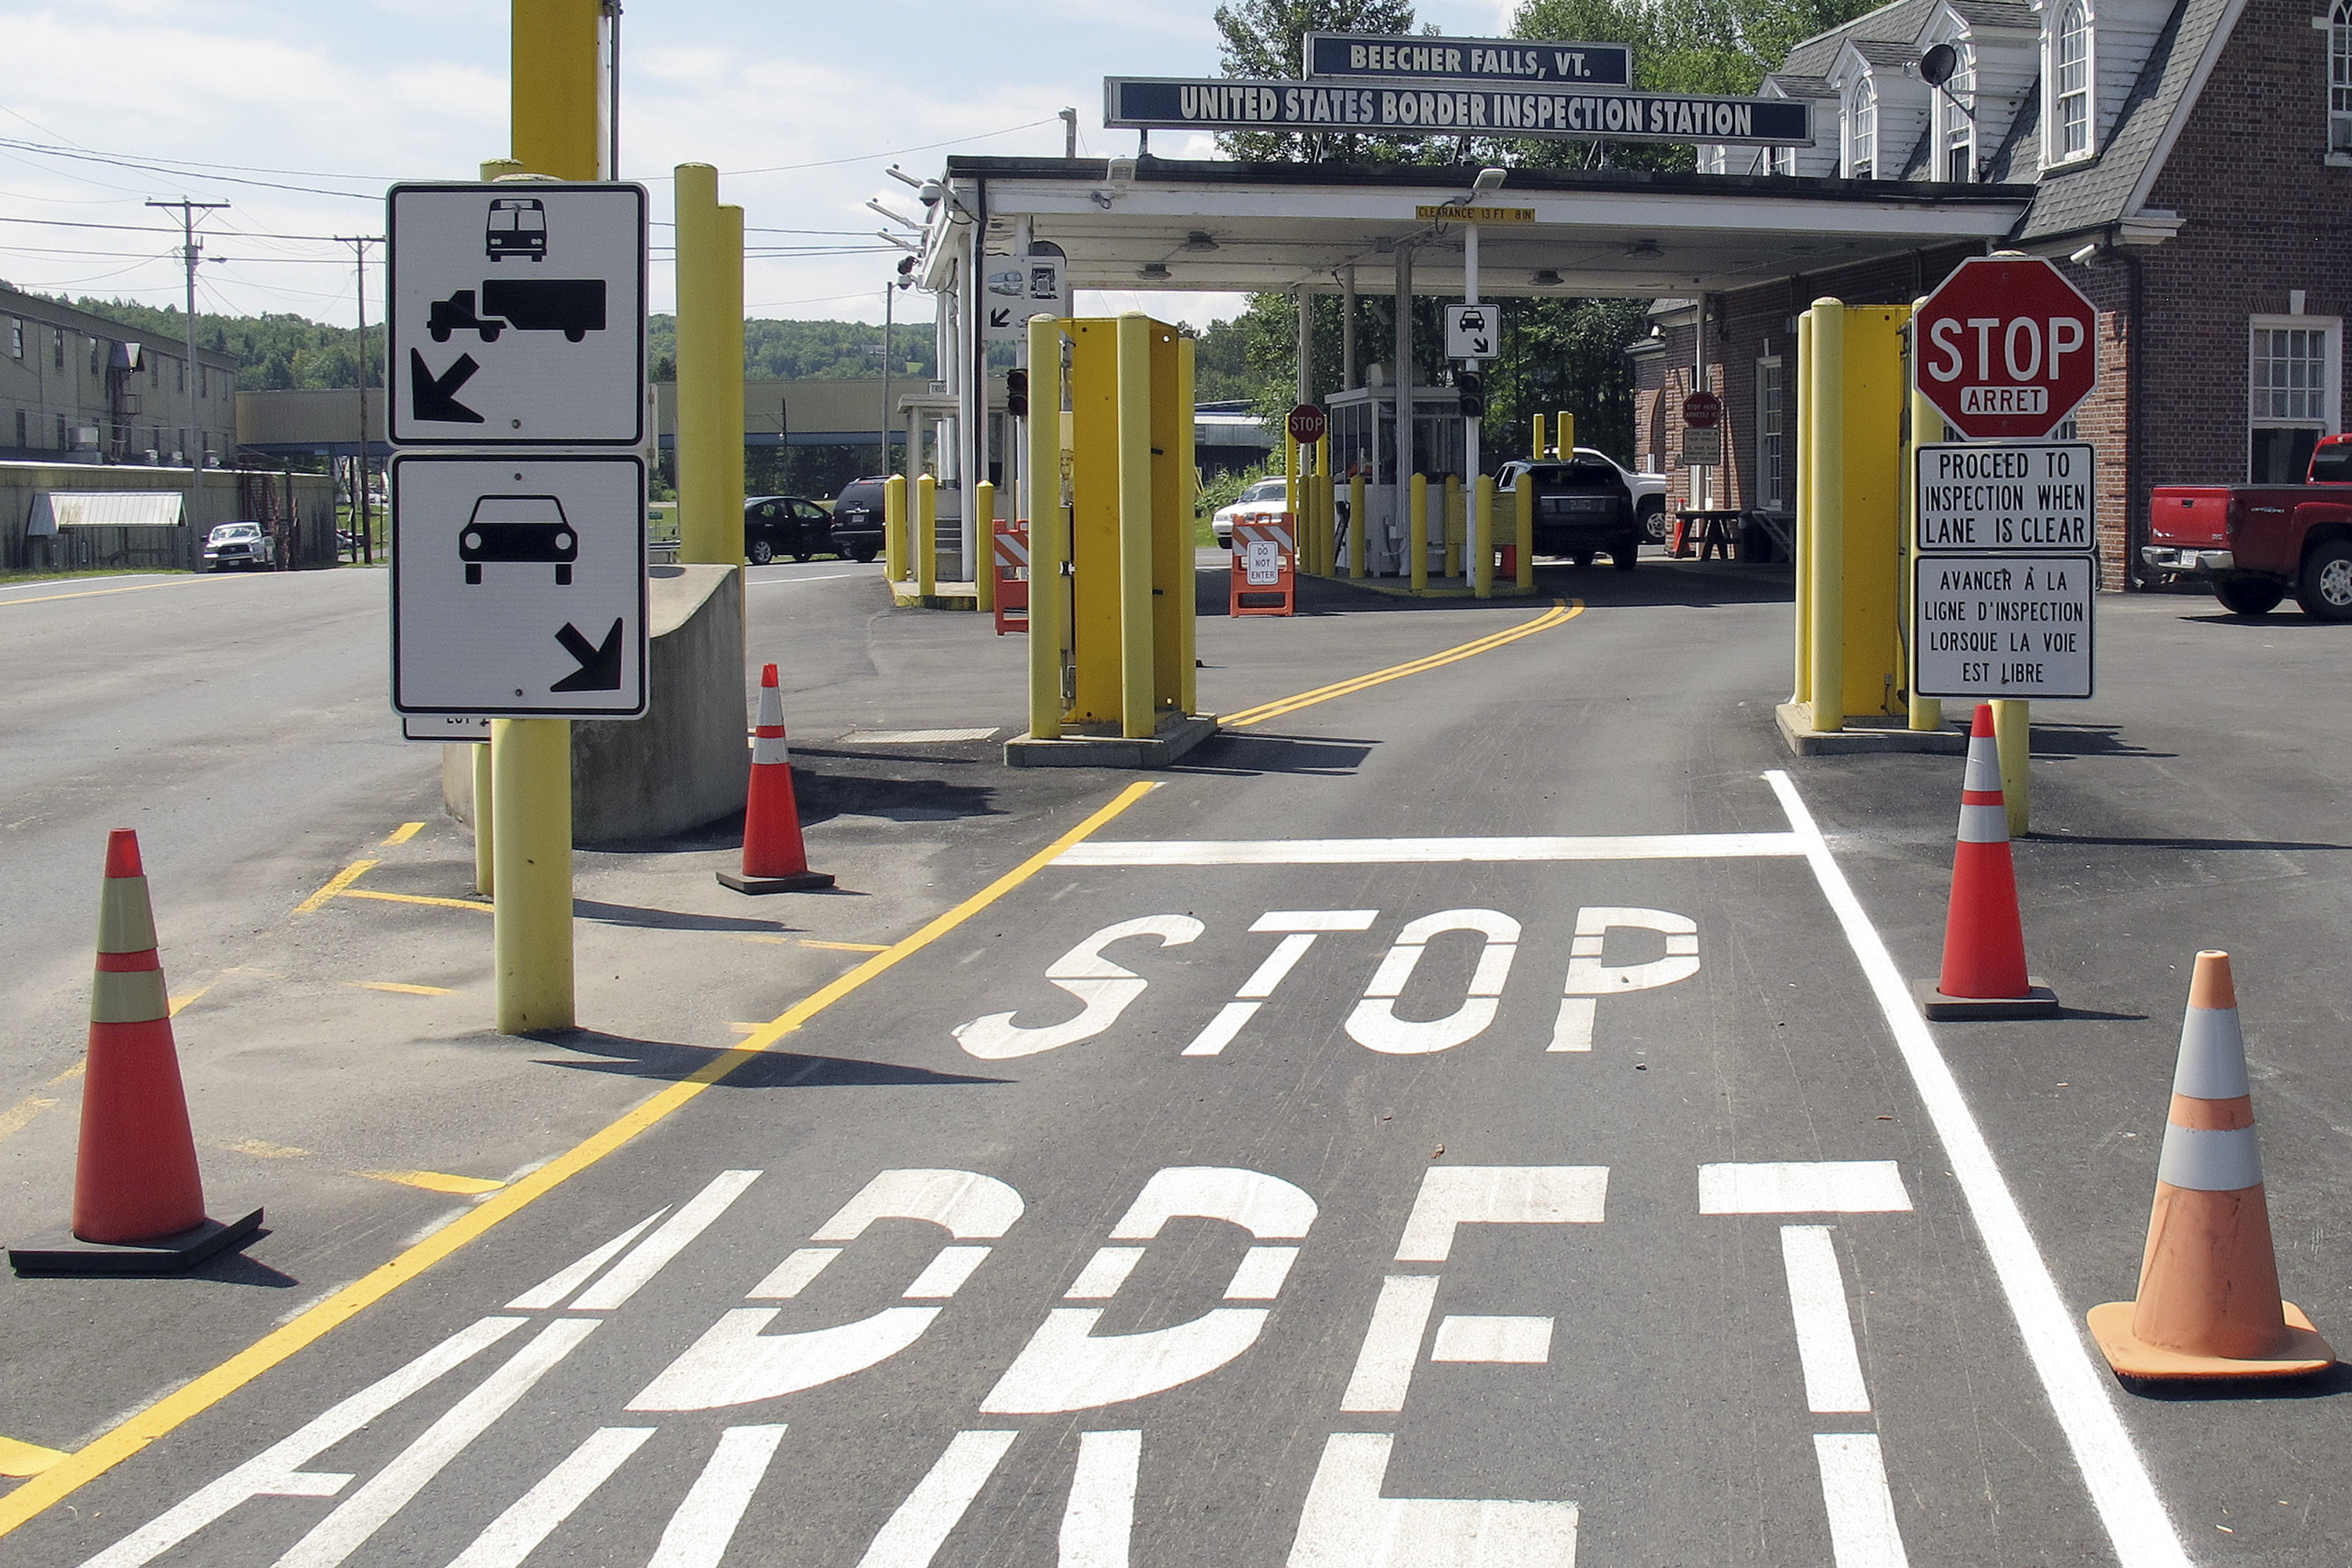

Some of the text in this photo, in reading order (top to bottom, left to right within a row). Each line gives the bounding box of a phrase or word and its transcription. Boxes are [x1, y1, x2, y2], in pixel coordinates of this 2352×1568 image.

[1350, 45, 1591, 79] BEECHER FALLS, VT.
[1180, 86, 1751, 136] UNITED STATES BORDER INSPECTION STATION
[1481, 208, 1490, 219] 13
[1494, 209, 1504, 219] FT
[1927, 316, 2085, 382] STOP
[1966, 388, 2042, 412] ARRET
[1290, 416, 1323, 431] STOP
[1940, 452, 2071, 479] PROCEED TO
[1926, 484, 2085, 512] INSPECTION WHEN
[1926, 517, 2085, 544] LANE IS CLEAR
[1251, 571, 1275, 579] ENTER
[1940, 566, 2068, 591] AVANCER À LA
[1925, 601, 2084, 622] LIGNE D'INSPECTION
[1930, 632, 2077, 653] LORSQUE LA VOIE
[1963, 662, 2044, 684] EST LIBRE
[951, 906, 1700, 1060] STOP
[74, 1161, 1914, 1568] ARRET
